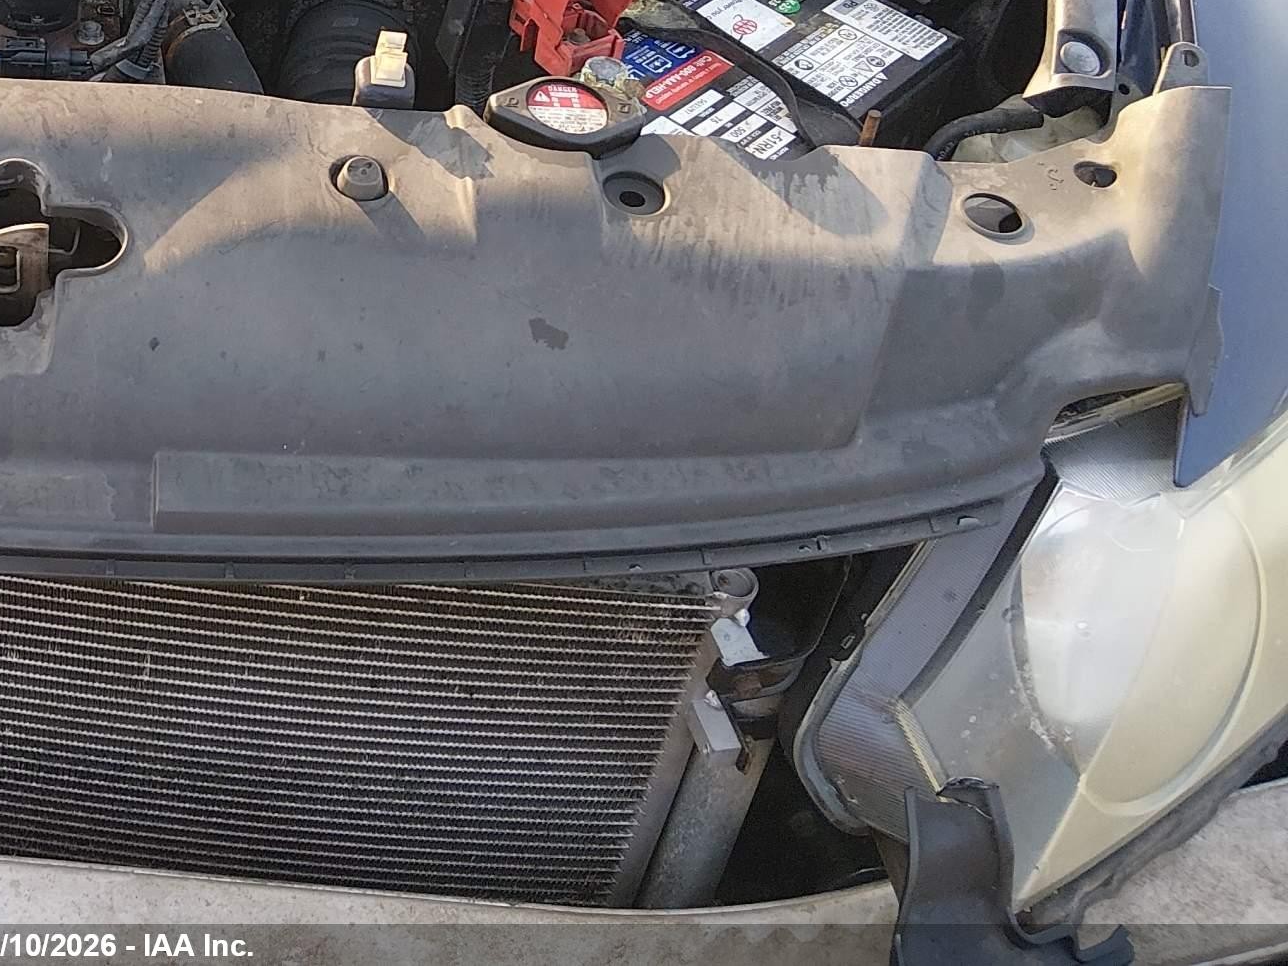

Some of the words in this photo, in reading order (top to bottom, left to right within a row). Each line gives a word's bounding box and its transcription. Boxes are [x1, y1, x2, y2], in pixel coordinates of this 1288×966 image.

[842, 0, 858, 8] Pb
[645, 64, 697, 99] 800-AAA-HELP
[730, 126, 746, 138] 500
